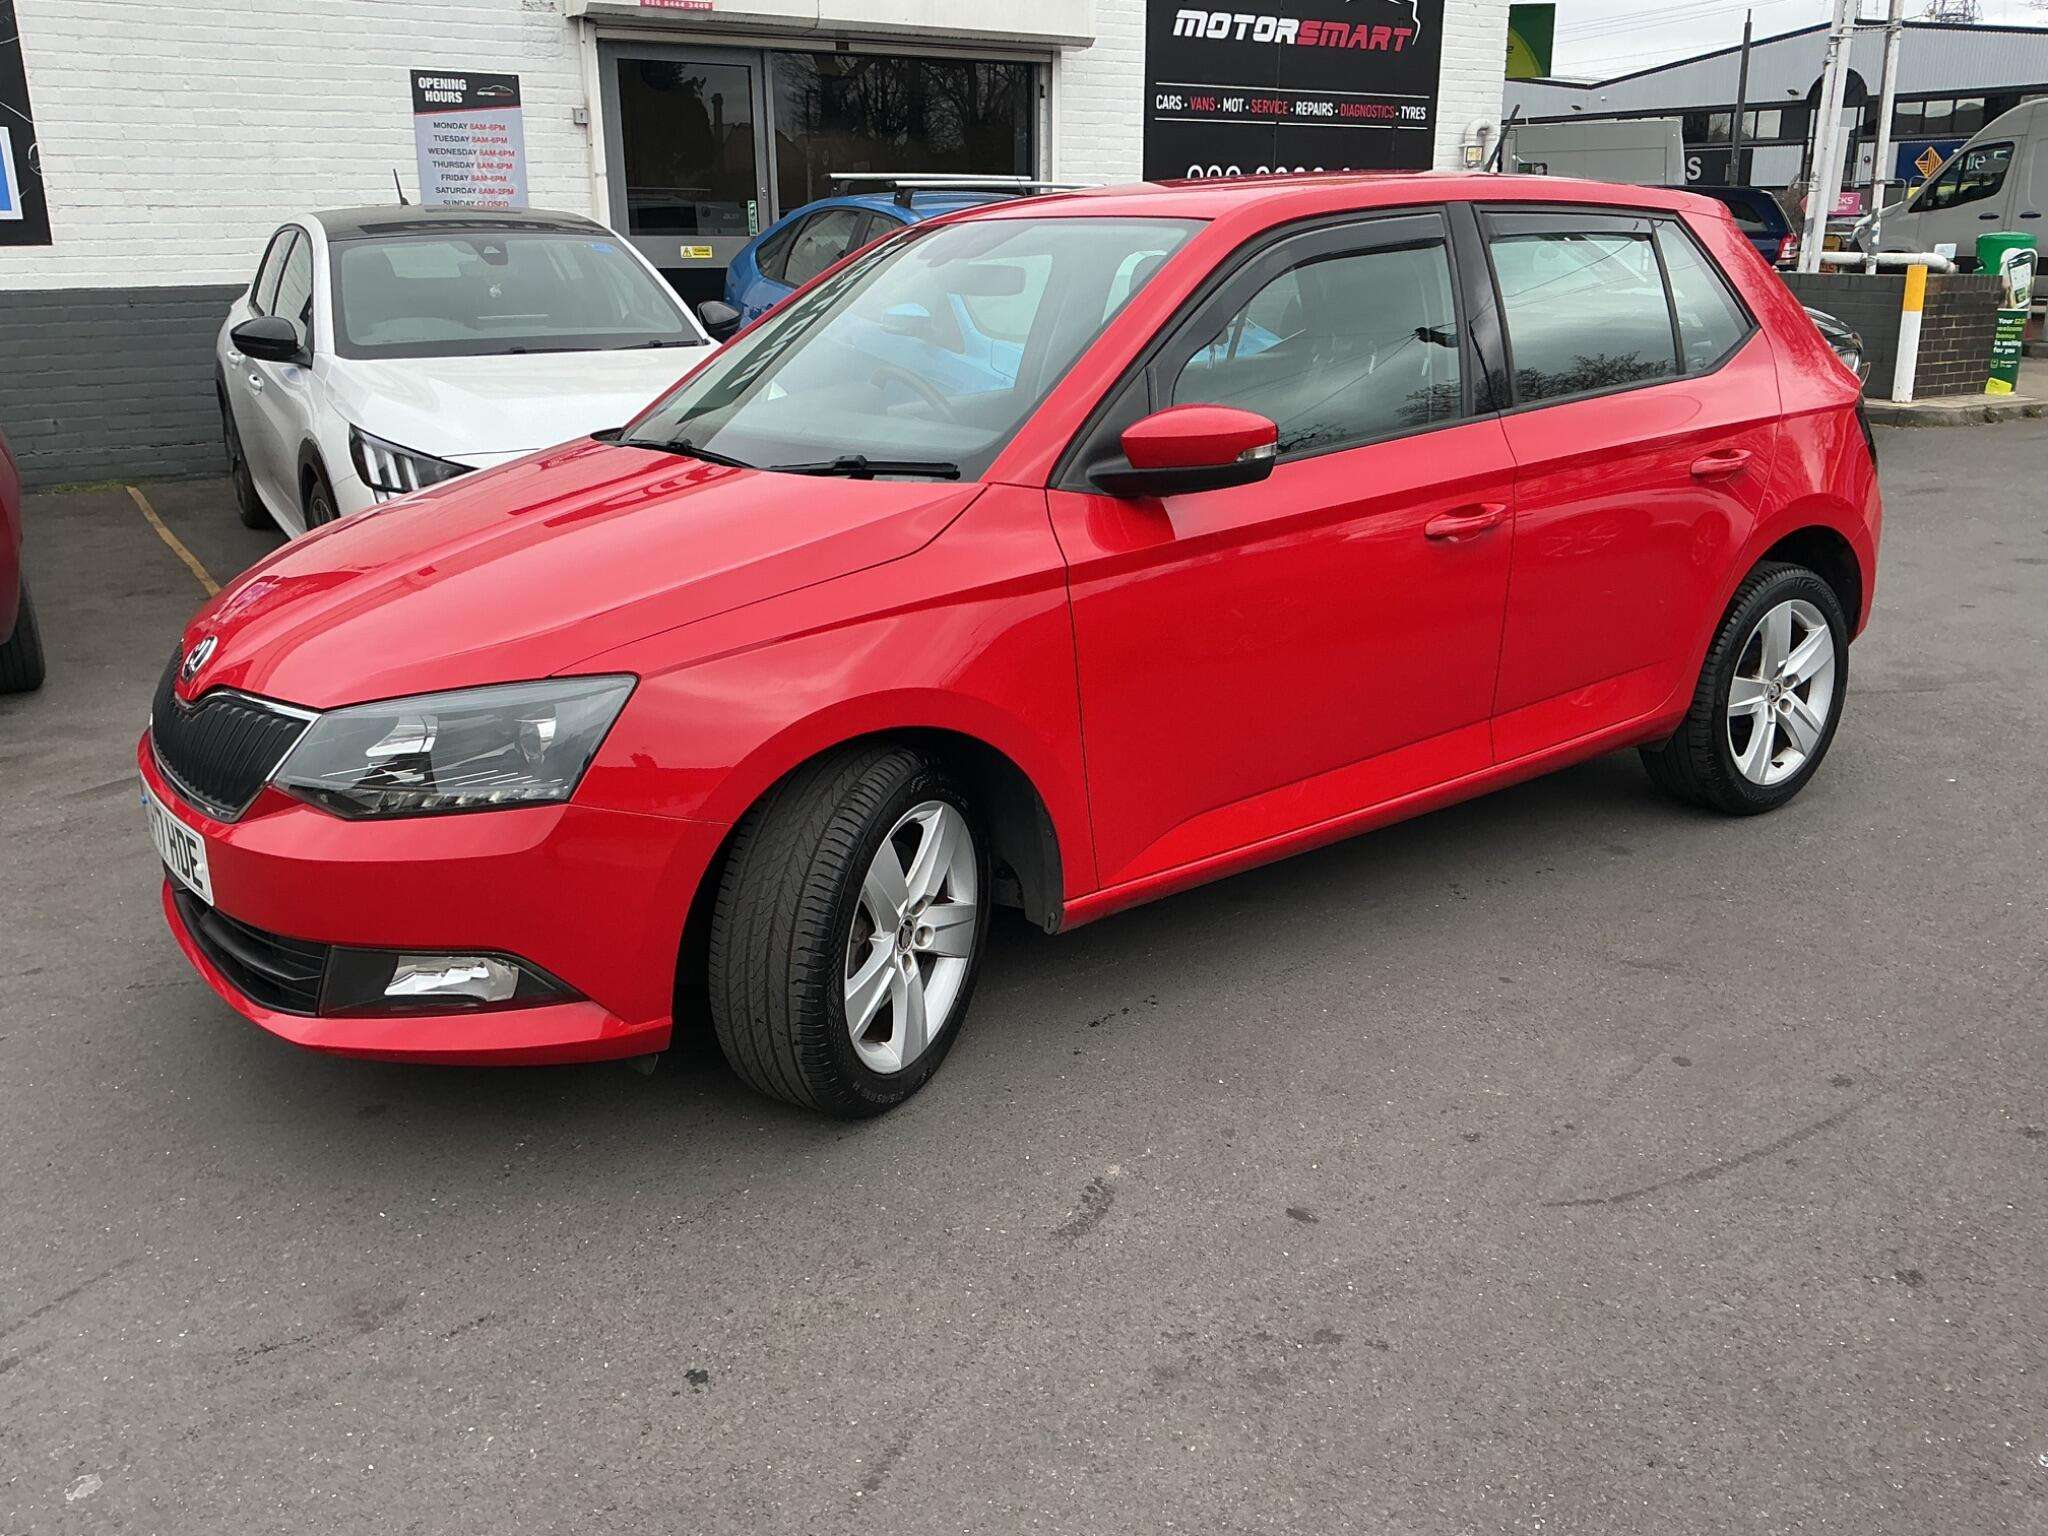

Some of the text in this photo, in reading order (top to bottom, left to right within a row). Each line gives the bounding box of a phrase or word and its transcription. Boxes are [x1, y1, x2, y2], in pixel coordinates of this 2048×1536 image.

[1172, 9, 1413, 52] MOTORSMART
[418, 77, 467, 90] OPENING
[425, 91, 463, 103] HOURS
[1155, 94, 1426, 120] CARS VANS MOT SERVICE REPAIRS DIAGNOSTICS TYRES
[433, 122, 468, 130] MONDAY
[433, 135, 470, 143] TUESDAY
[427, 148, 477, 156] WEDNESDAY
[432, 161, 475, 169] THURSDAY
[440, 174, 469, 182] FRIDAY
[435, 187, 477, 195] SATURDAY
[477, 200, 509, 208] CLOSED
[2004, 347, 2016, 355] you
